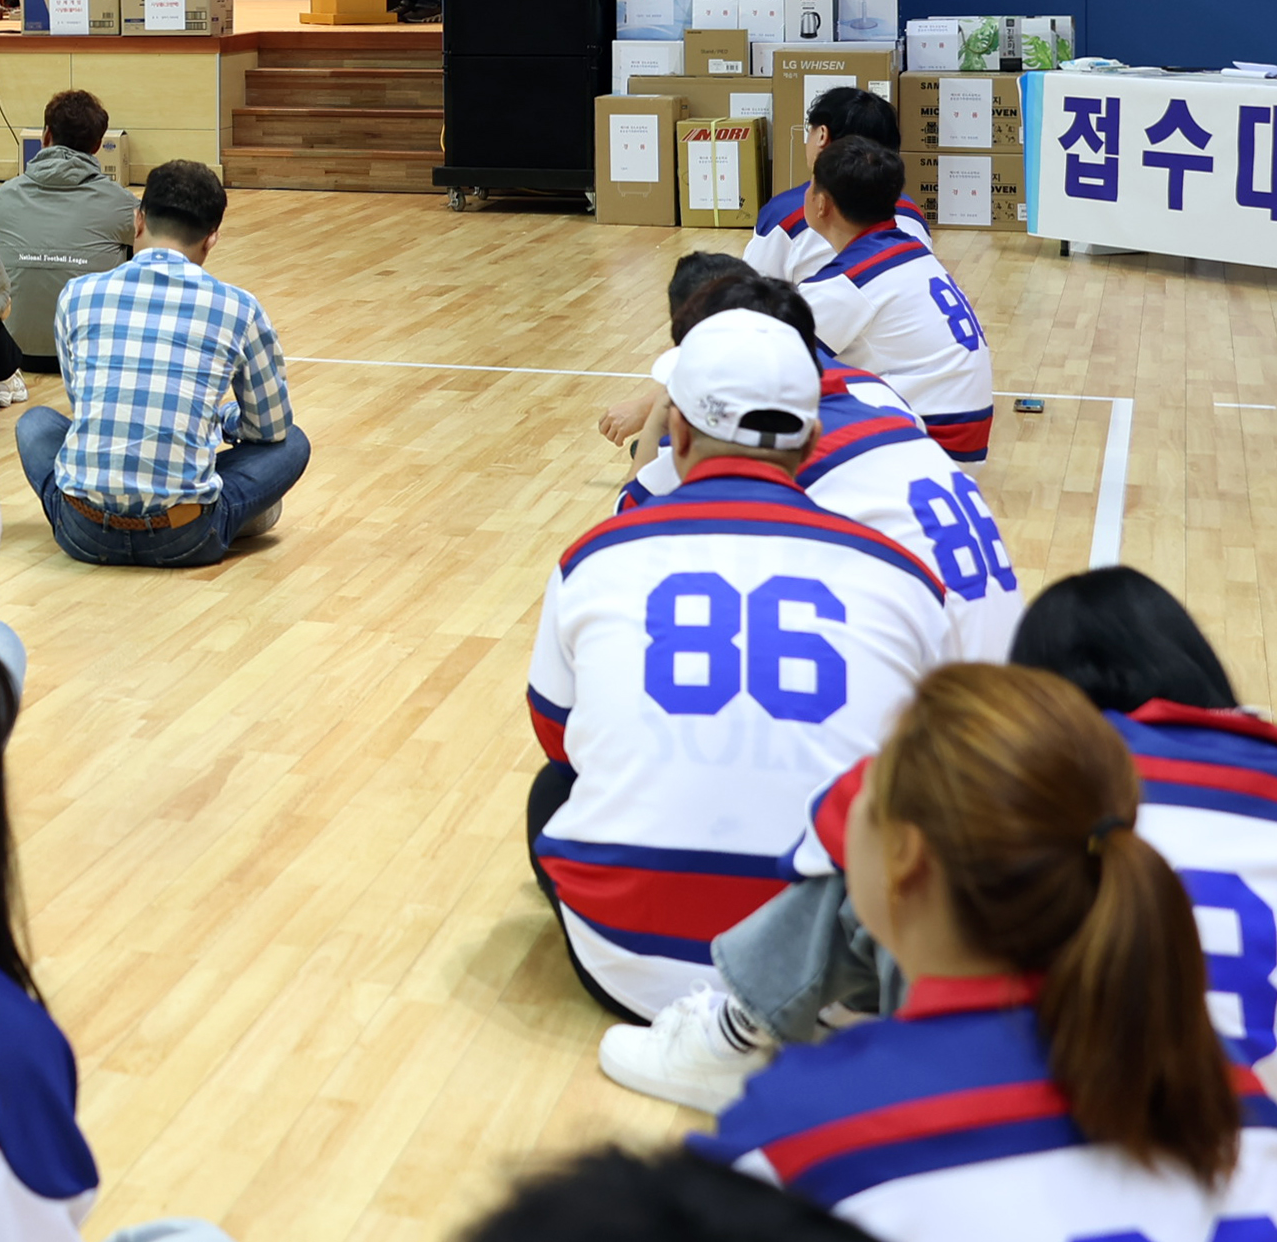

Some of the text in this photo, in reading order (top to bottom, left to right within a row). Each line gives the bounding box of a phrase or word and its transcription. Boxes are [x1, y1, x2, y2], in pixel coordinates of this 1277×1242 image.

[782, 60, 845, 70] LG WHISEN
[19, 253, 88, 265] National Football League
[644, 572, 847, 724] 86
